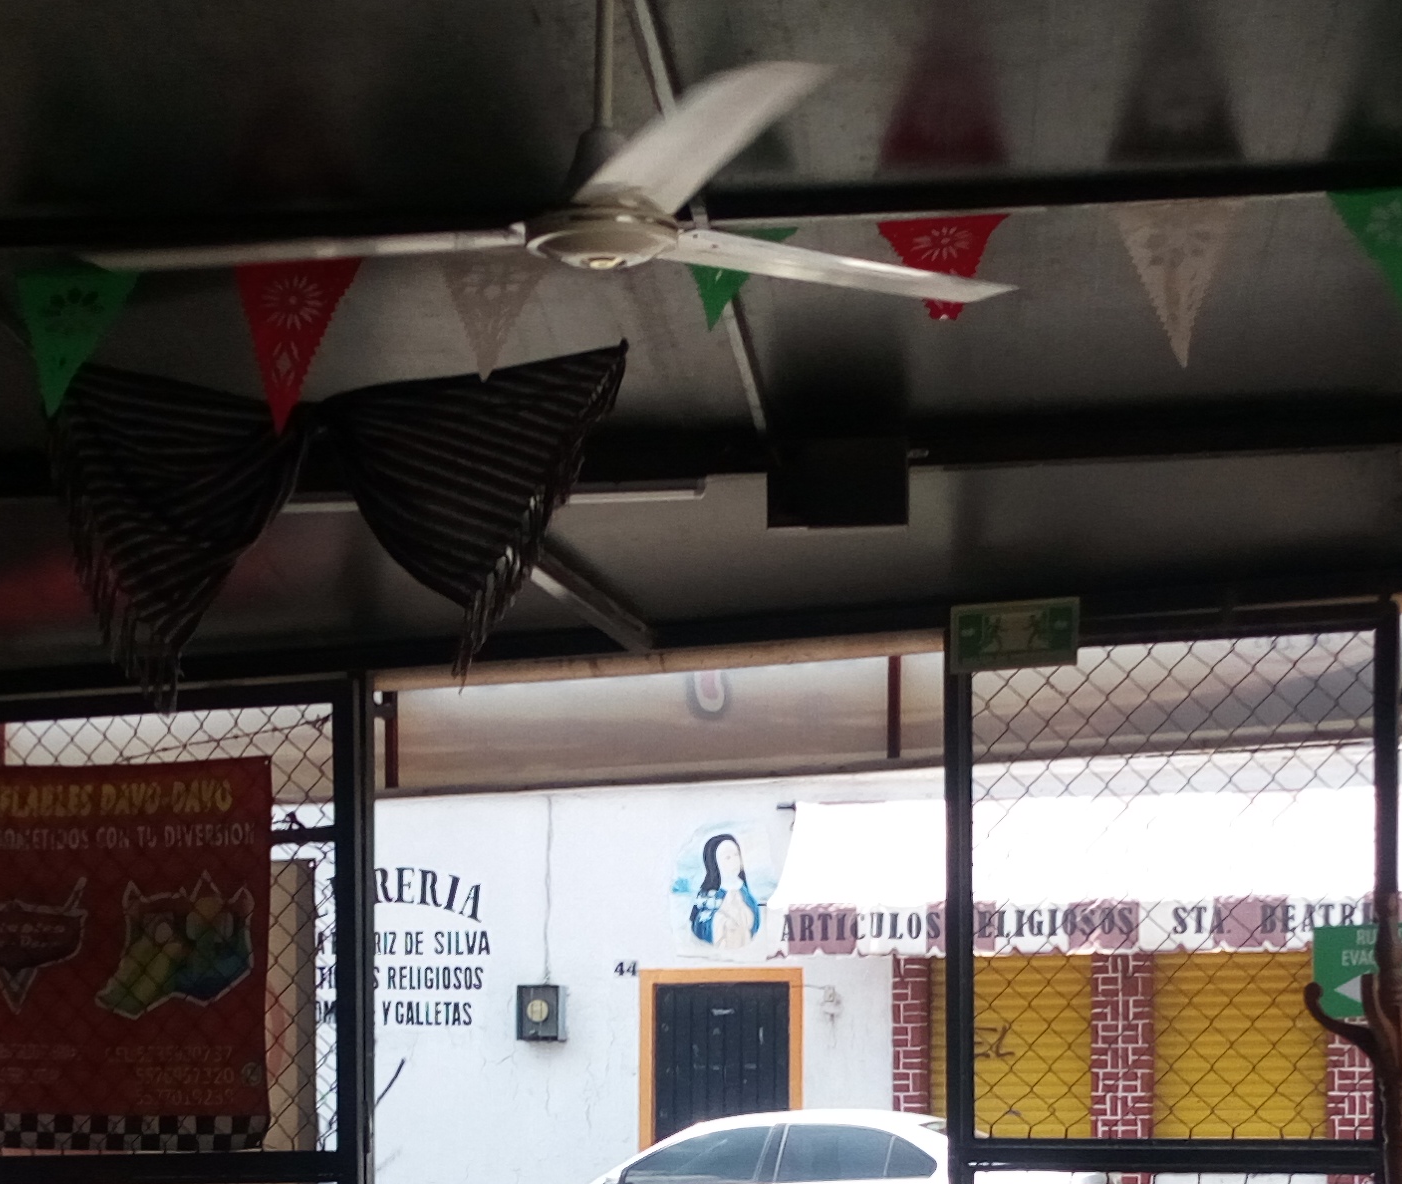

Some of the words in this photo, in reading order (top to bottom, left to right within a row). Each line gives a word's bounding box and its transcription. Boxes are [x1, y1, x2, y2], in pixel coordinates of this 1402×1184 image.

[96, 826, 129, 849] CON
[780, 907, 941, 942] ARTICULOS
[978, 906, 1133, 940] ELIGIOSOS
[1260, 904, 1378, 934] BEATRI
[405, 931, 424, 955] DE
[434, 930, 490, 955] SILVA
[387, 966, 484, 991] RELIGIOSOS
[614, 961, 637, 977] 44
[382, 1000, 391, 1026] Y
[395, 1001, 473, 1026] GALLETAS
